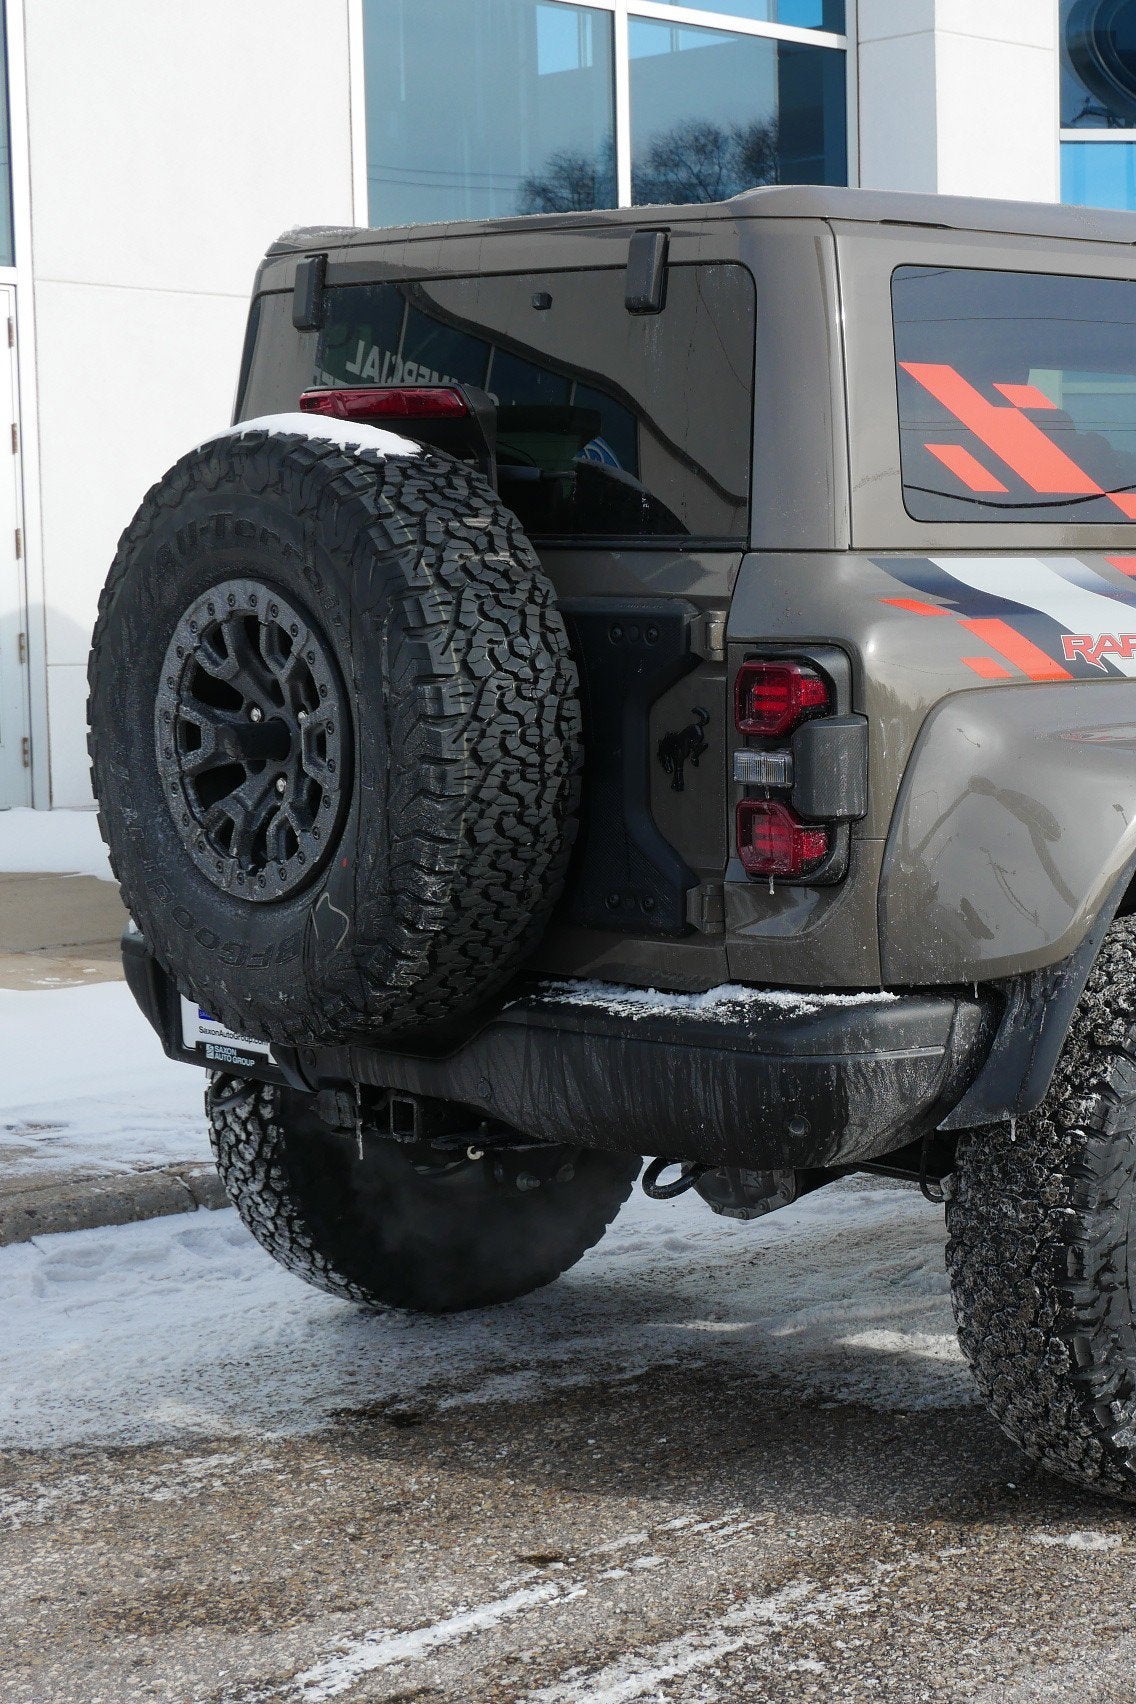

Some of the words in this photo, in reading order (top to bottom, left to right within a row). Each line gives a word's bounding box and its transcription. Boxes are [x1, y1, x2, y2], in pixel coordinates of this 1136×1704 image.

[214, 1045, 237, 1056] SAXON
[214, 1052, 232, 1063] AUTO
[232, 1056, 255, 1066] GROUP
